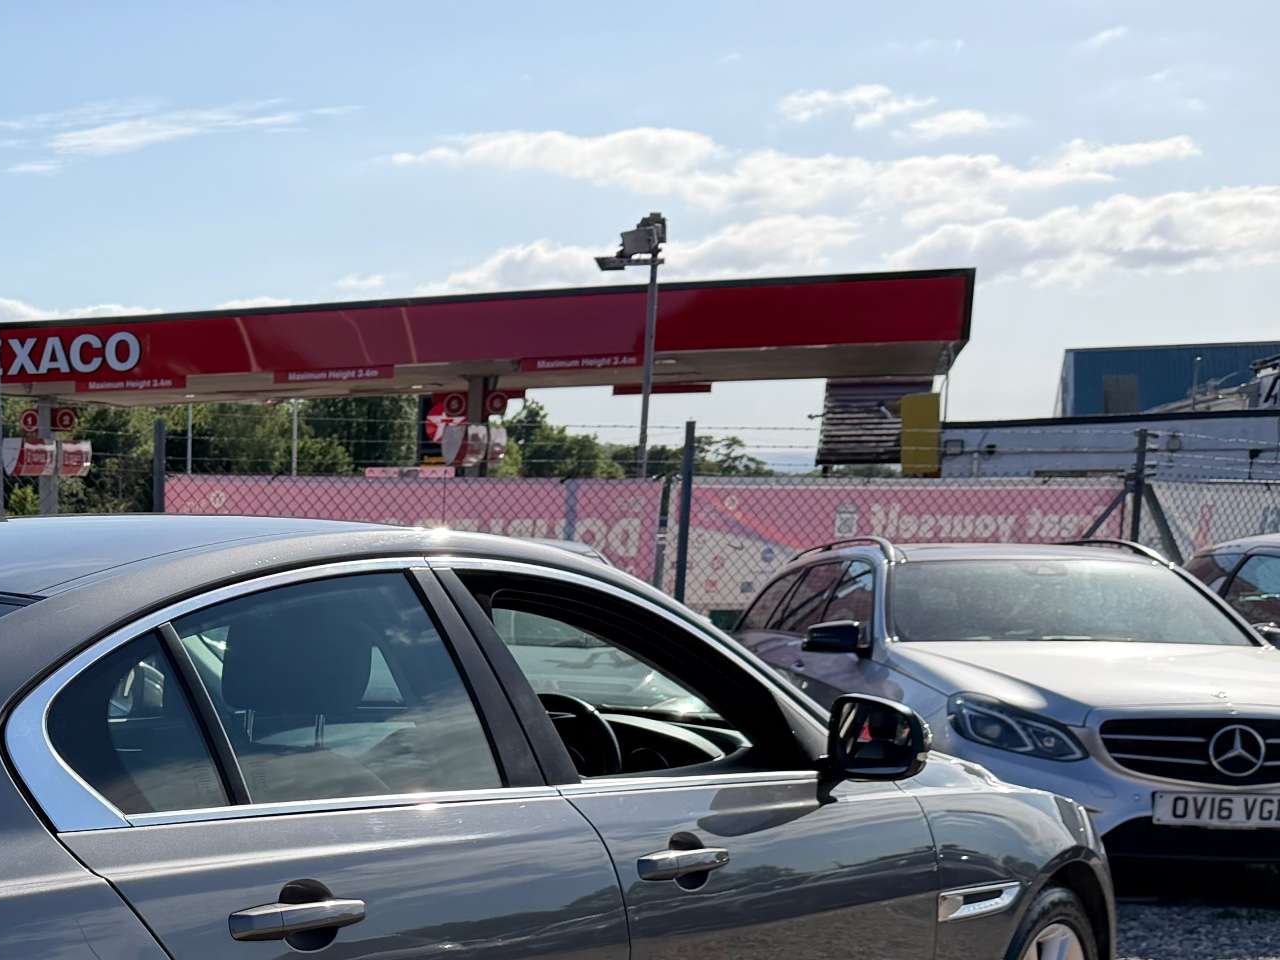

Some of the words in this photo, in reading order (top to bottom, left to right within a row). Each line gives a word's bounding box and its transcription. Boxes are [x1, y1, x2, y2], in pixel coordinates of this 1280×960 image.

[536, 360, 579, 368] Maximum
[581, 358, 611, 367] Height
[287, 371, 327, 380] Maximum
[328, 370, 356, 380] Height
[88, 381, 124, 389] Maximum
[126, 380, 151, 389] Height
[1172, 796, 1233, 820] OV16
[1243, 798, 1280, 821] VG
